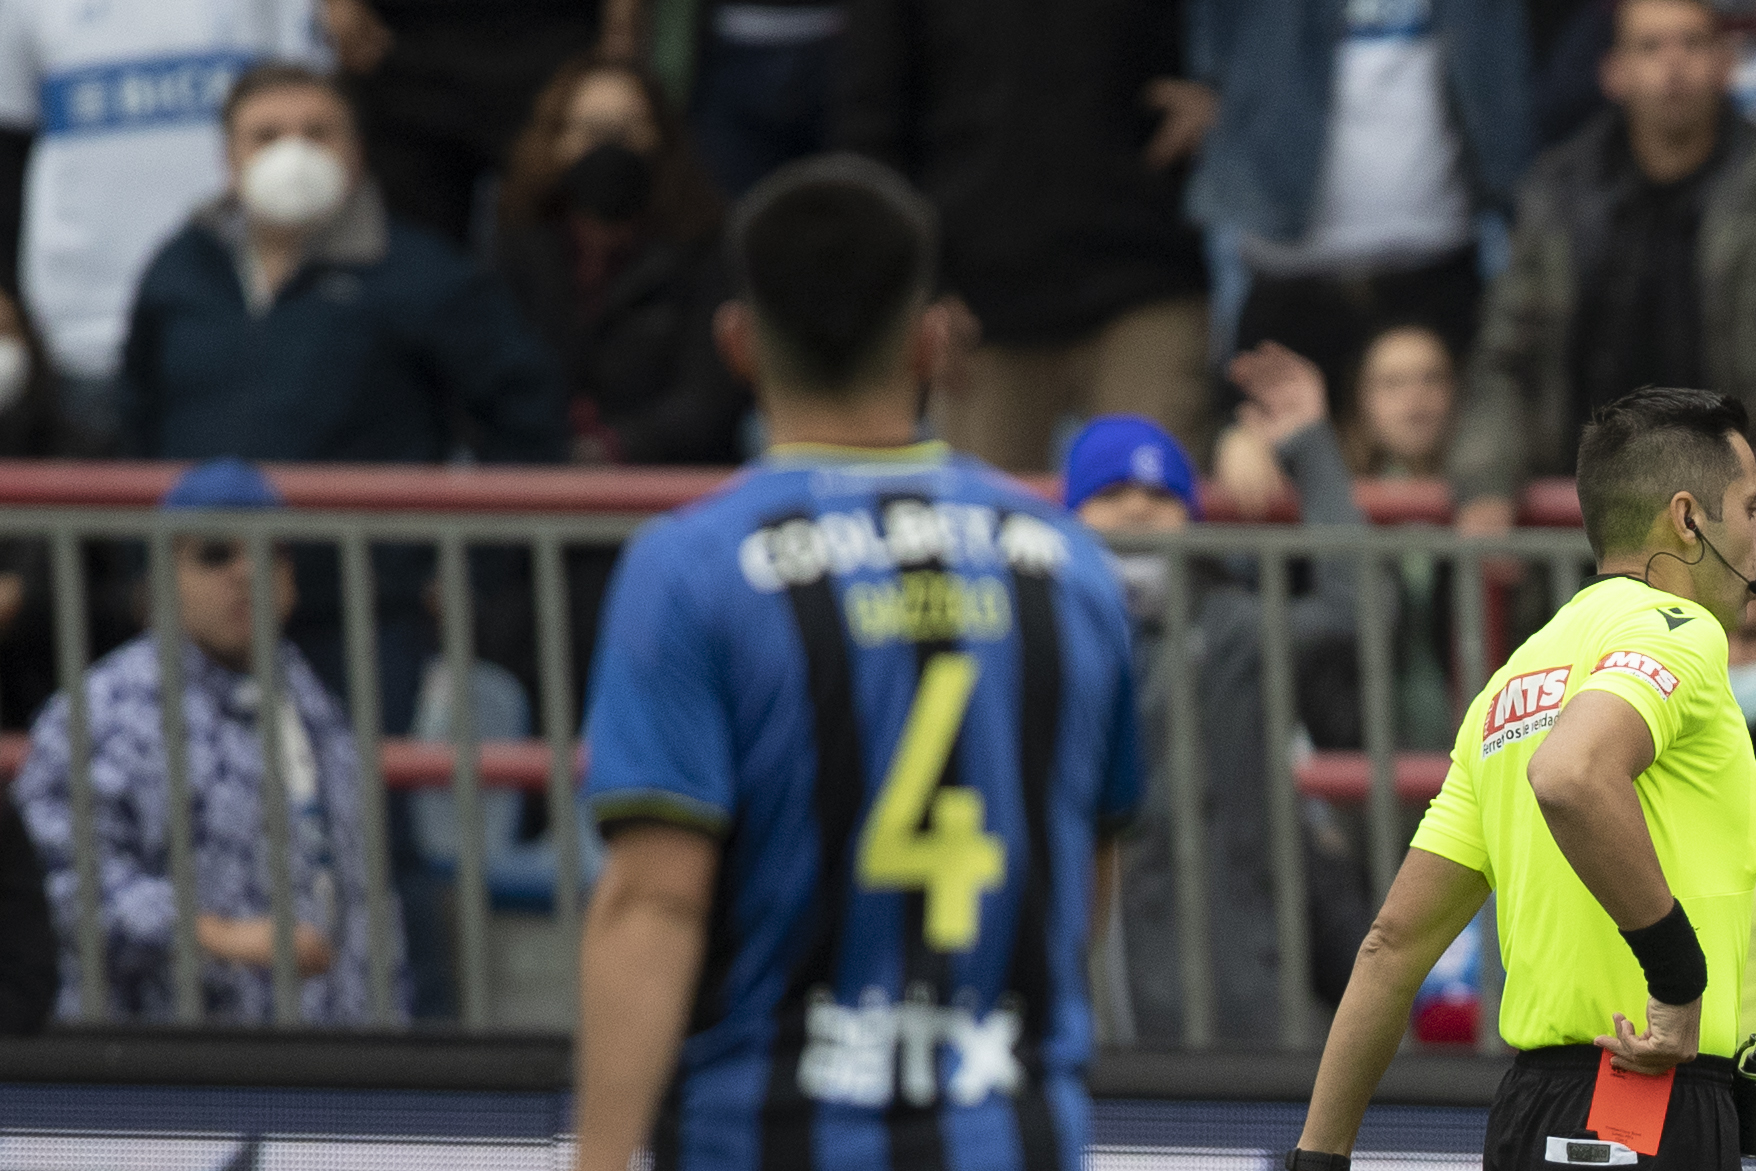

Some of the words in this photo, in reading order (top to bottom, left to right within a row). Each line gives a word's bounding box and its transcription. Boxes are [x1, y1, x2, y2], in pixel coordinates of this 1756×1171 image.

[1494, 669, 1570, 728] MTS
[1604, 650, 1675, 693] MTS
[857, 651, 1007, 952] 4
